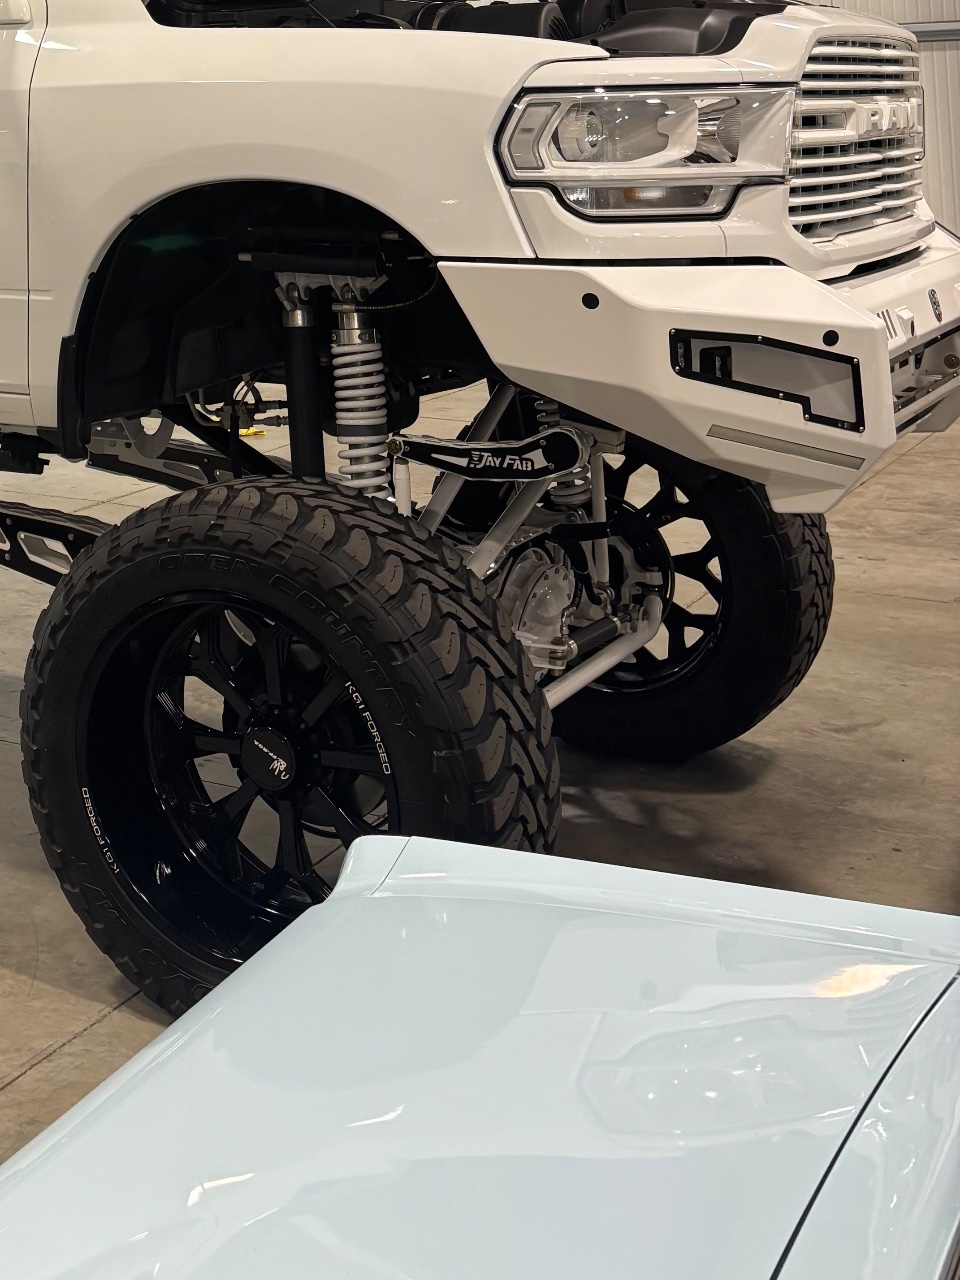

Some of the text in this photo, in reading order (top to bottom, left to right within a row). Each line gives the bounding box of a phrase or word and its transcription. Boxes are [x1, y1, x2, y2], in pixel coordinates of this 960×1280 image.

[861, 97, 923, 134] RAM
[475, 452, 532, 471] JAY FAB
[362, 711, 391, 775] FORGED
[81, 787, 105, 845] FORGED
